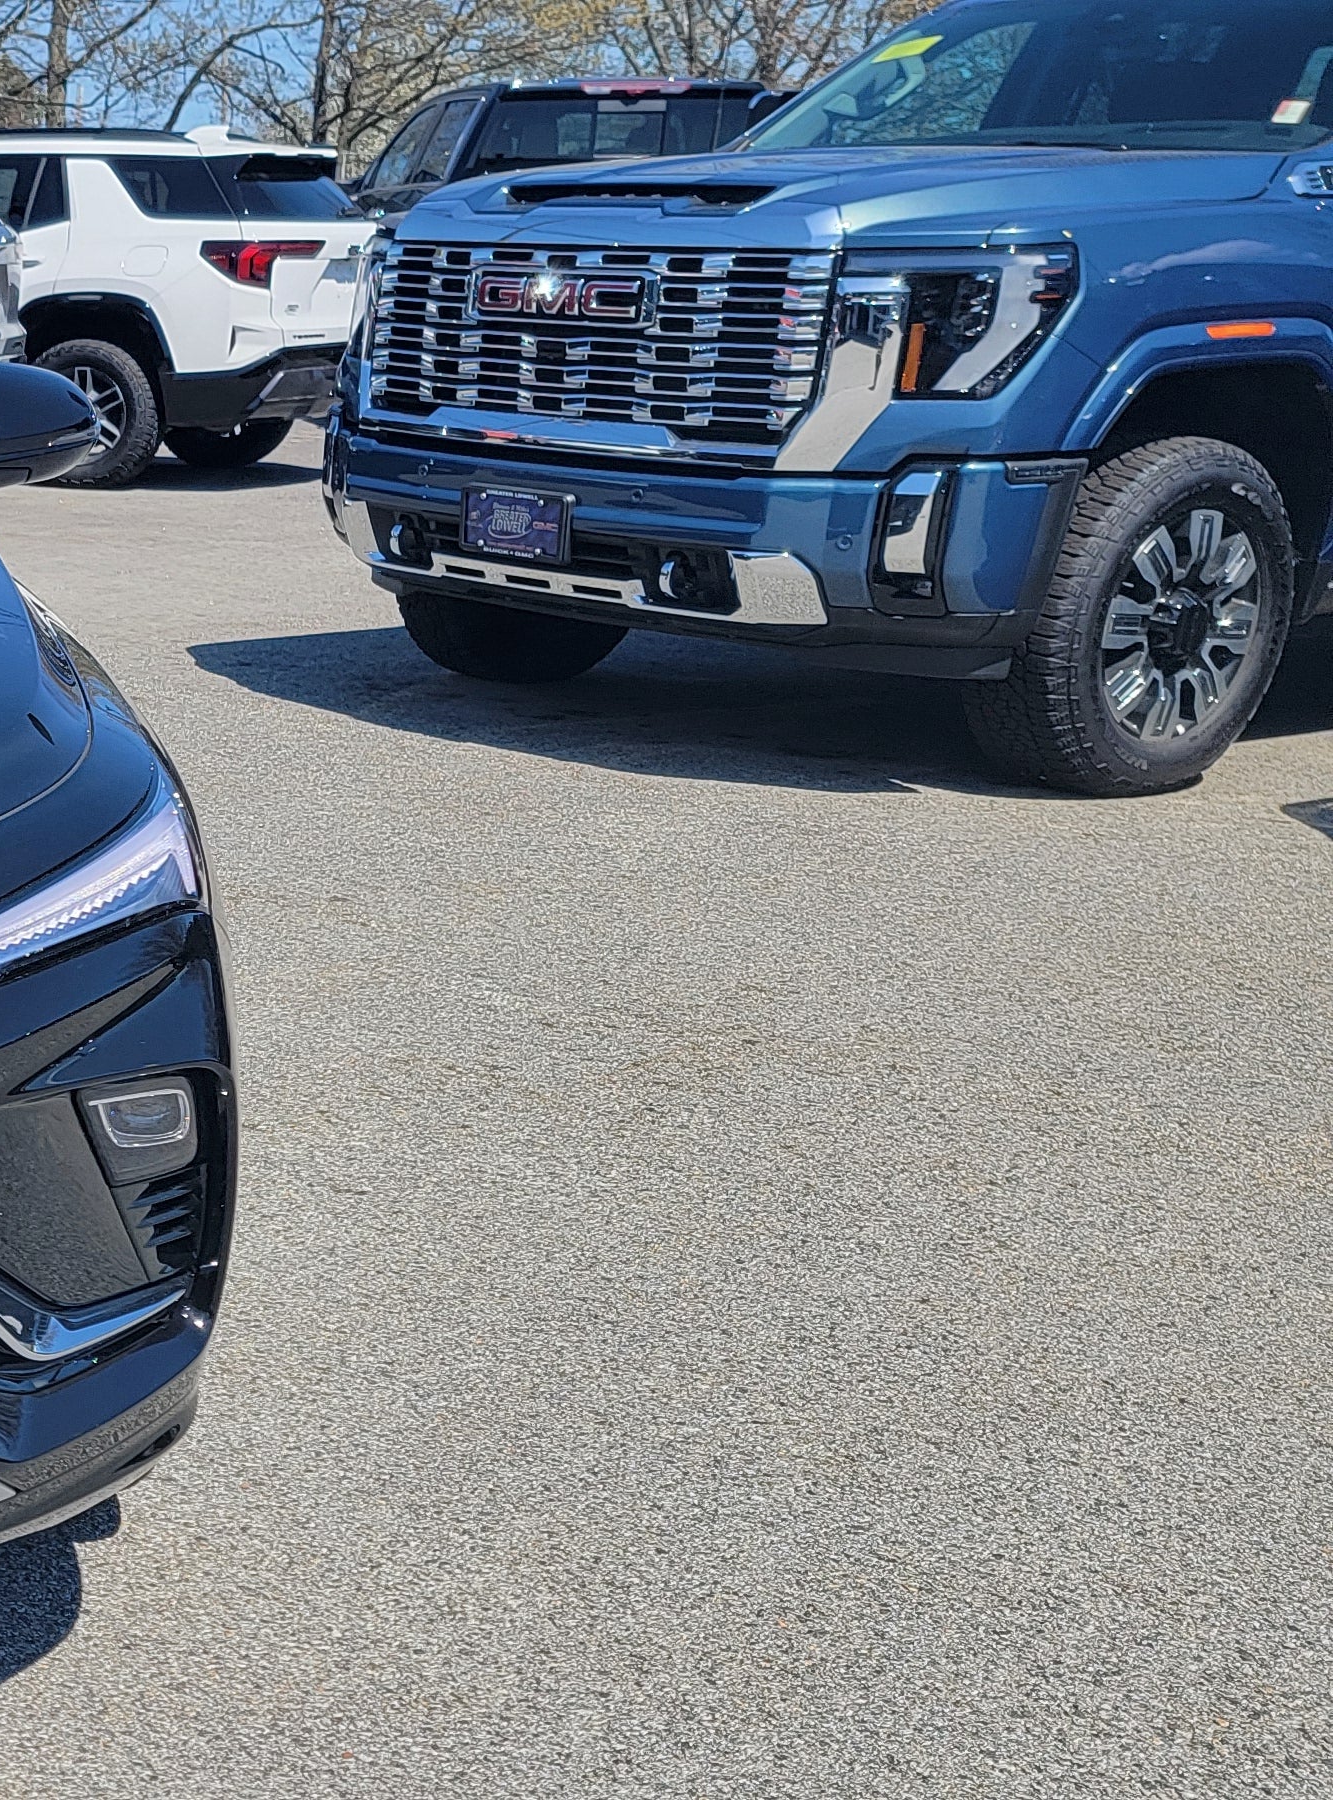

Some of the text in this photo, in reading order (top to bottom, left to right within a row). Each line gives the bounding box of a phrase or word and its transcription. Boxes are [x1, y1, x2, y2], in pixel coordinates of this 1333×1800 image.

[476, 275, 641, 319] GMC
[493, 509, 531, 524] GREATER
[491, 519, 527, 534] LOWELL
